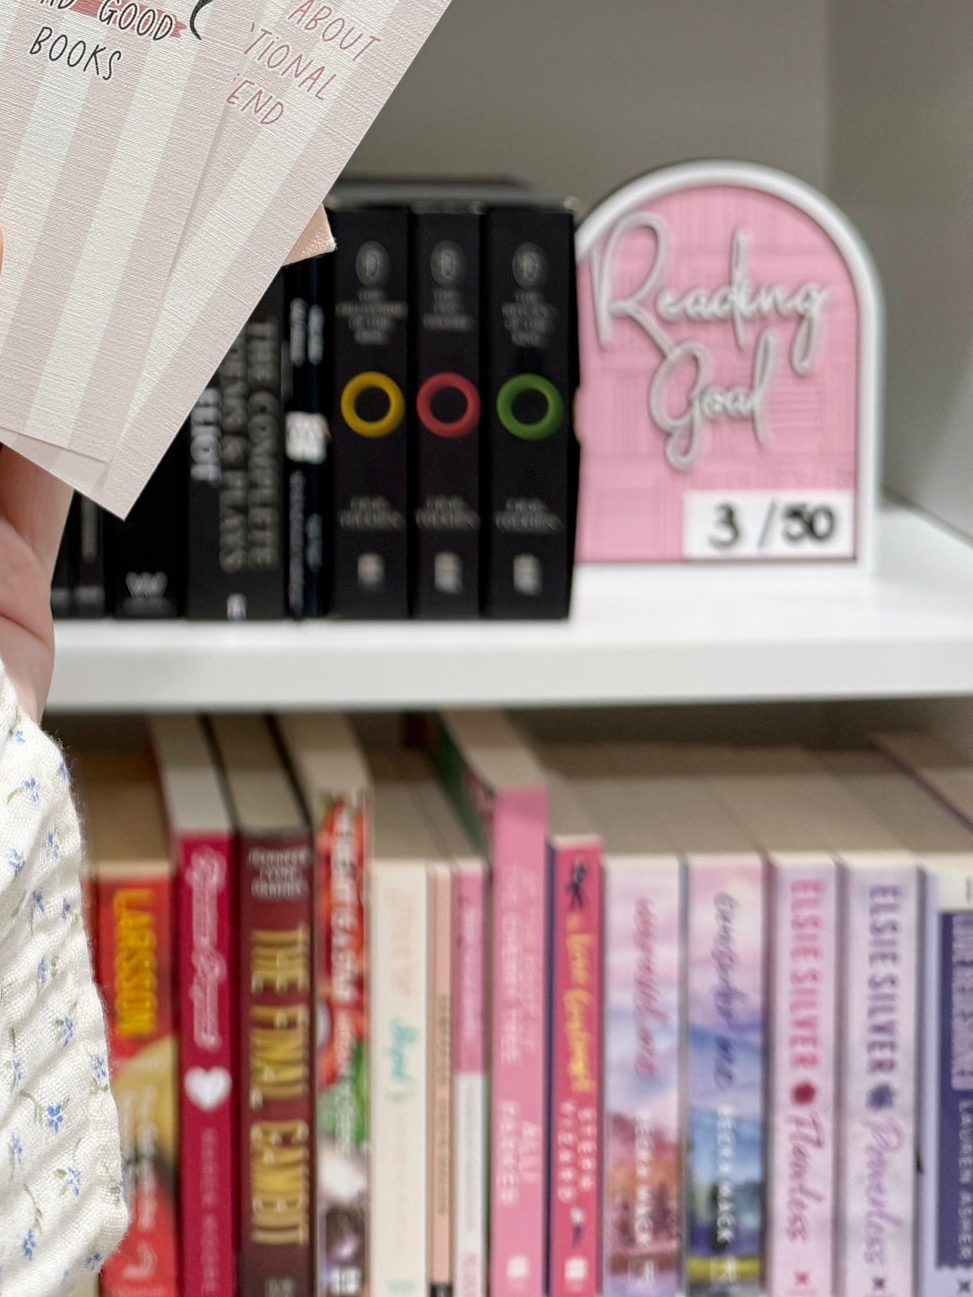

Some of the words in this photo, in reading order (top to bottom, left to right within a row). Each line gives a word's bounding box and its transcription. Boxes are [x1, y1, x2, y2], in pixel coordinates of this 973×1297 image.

[29, 26, 122, 81] BOOKS
[227, 76, 285, 126] END
[244, 23, 337, 101] TIONAL
[589, 212, 830, 376] Reading
[649, 330, 779, 471] Goal
[112, 888, 158, 1040] LARSSON
[250, 924, 310, 995] THE
[791, 880, 823, 963] ELSIE
[868, 884, 901, 966] ELSIE
[250, 1004, 310, 1110] FINAL
[790, 968, 822, 1071] SILVER
[868, 972, 901, 1075] SILVER
[250, 1120, 310, 1245] GAMBIT
[862, 1116, 905, 1267] Powerless
